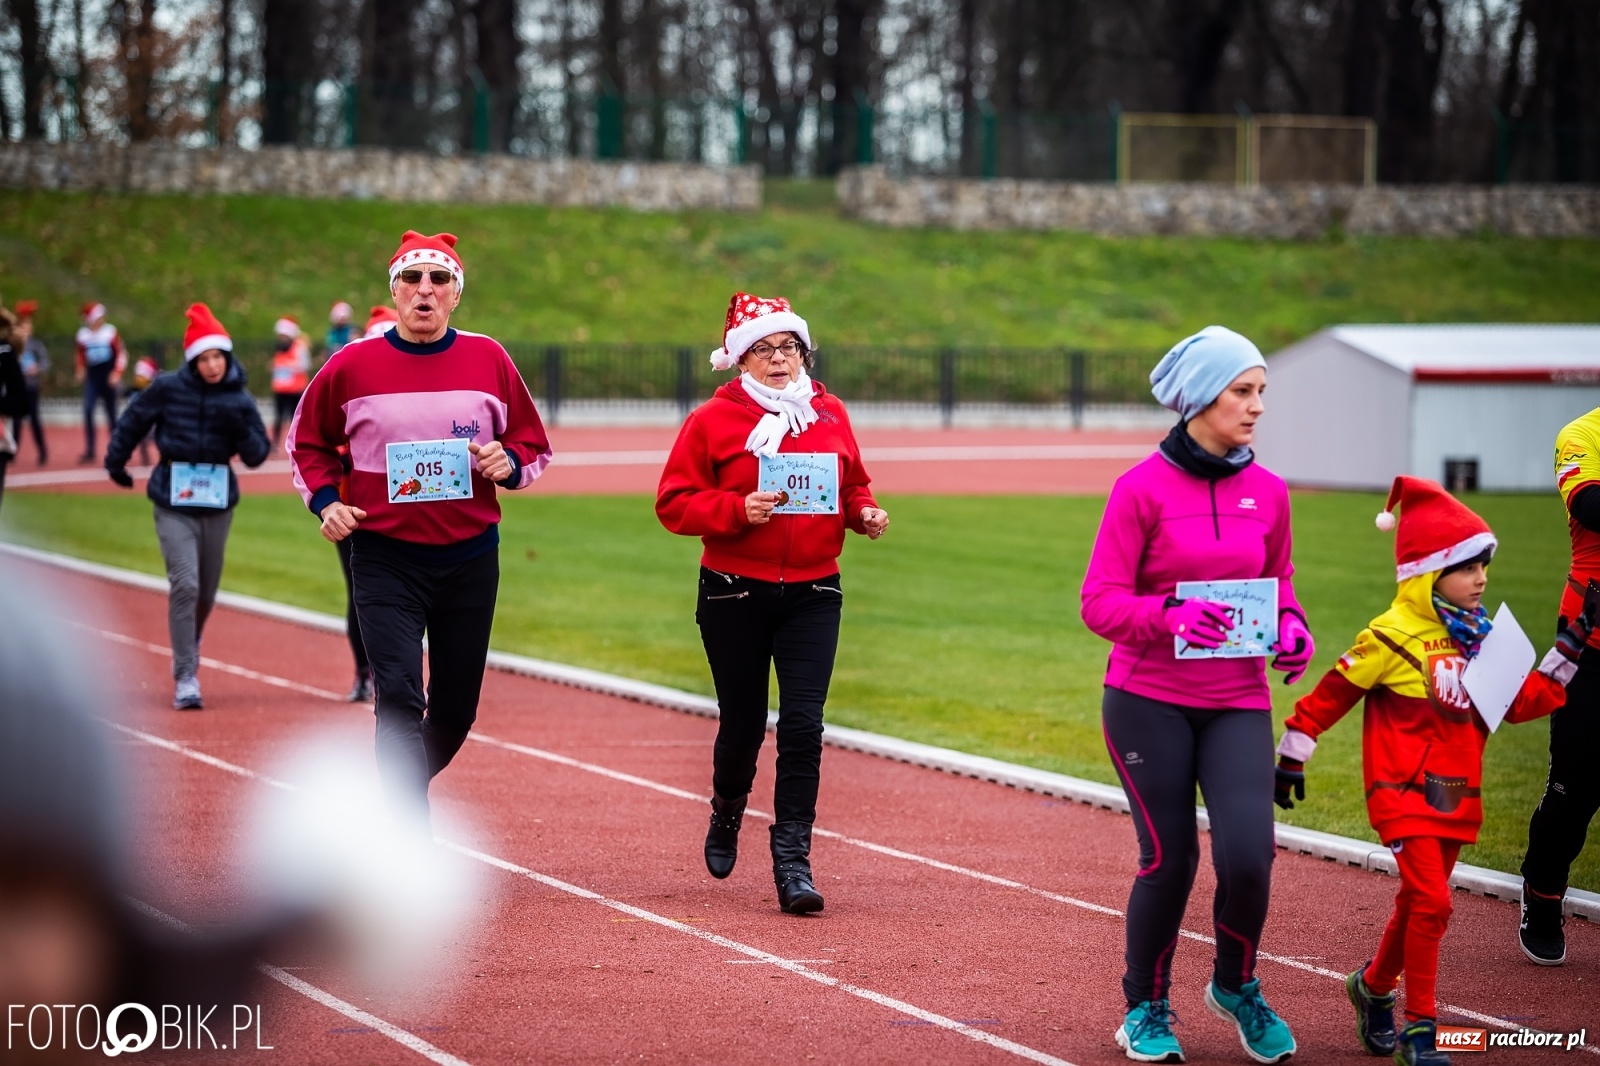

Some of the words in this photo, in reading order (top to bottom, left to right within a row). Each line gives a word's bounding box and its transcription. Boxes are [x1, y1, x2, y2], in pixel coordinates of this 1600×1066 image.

[415, 461, 443, 477] 015
[787, 474, 810, 490] 011
[1223, 607, 1244, 625] 71
